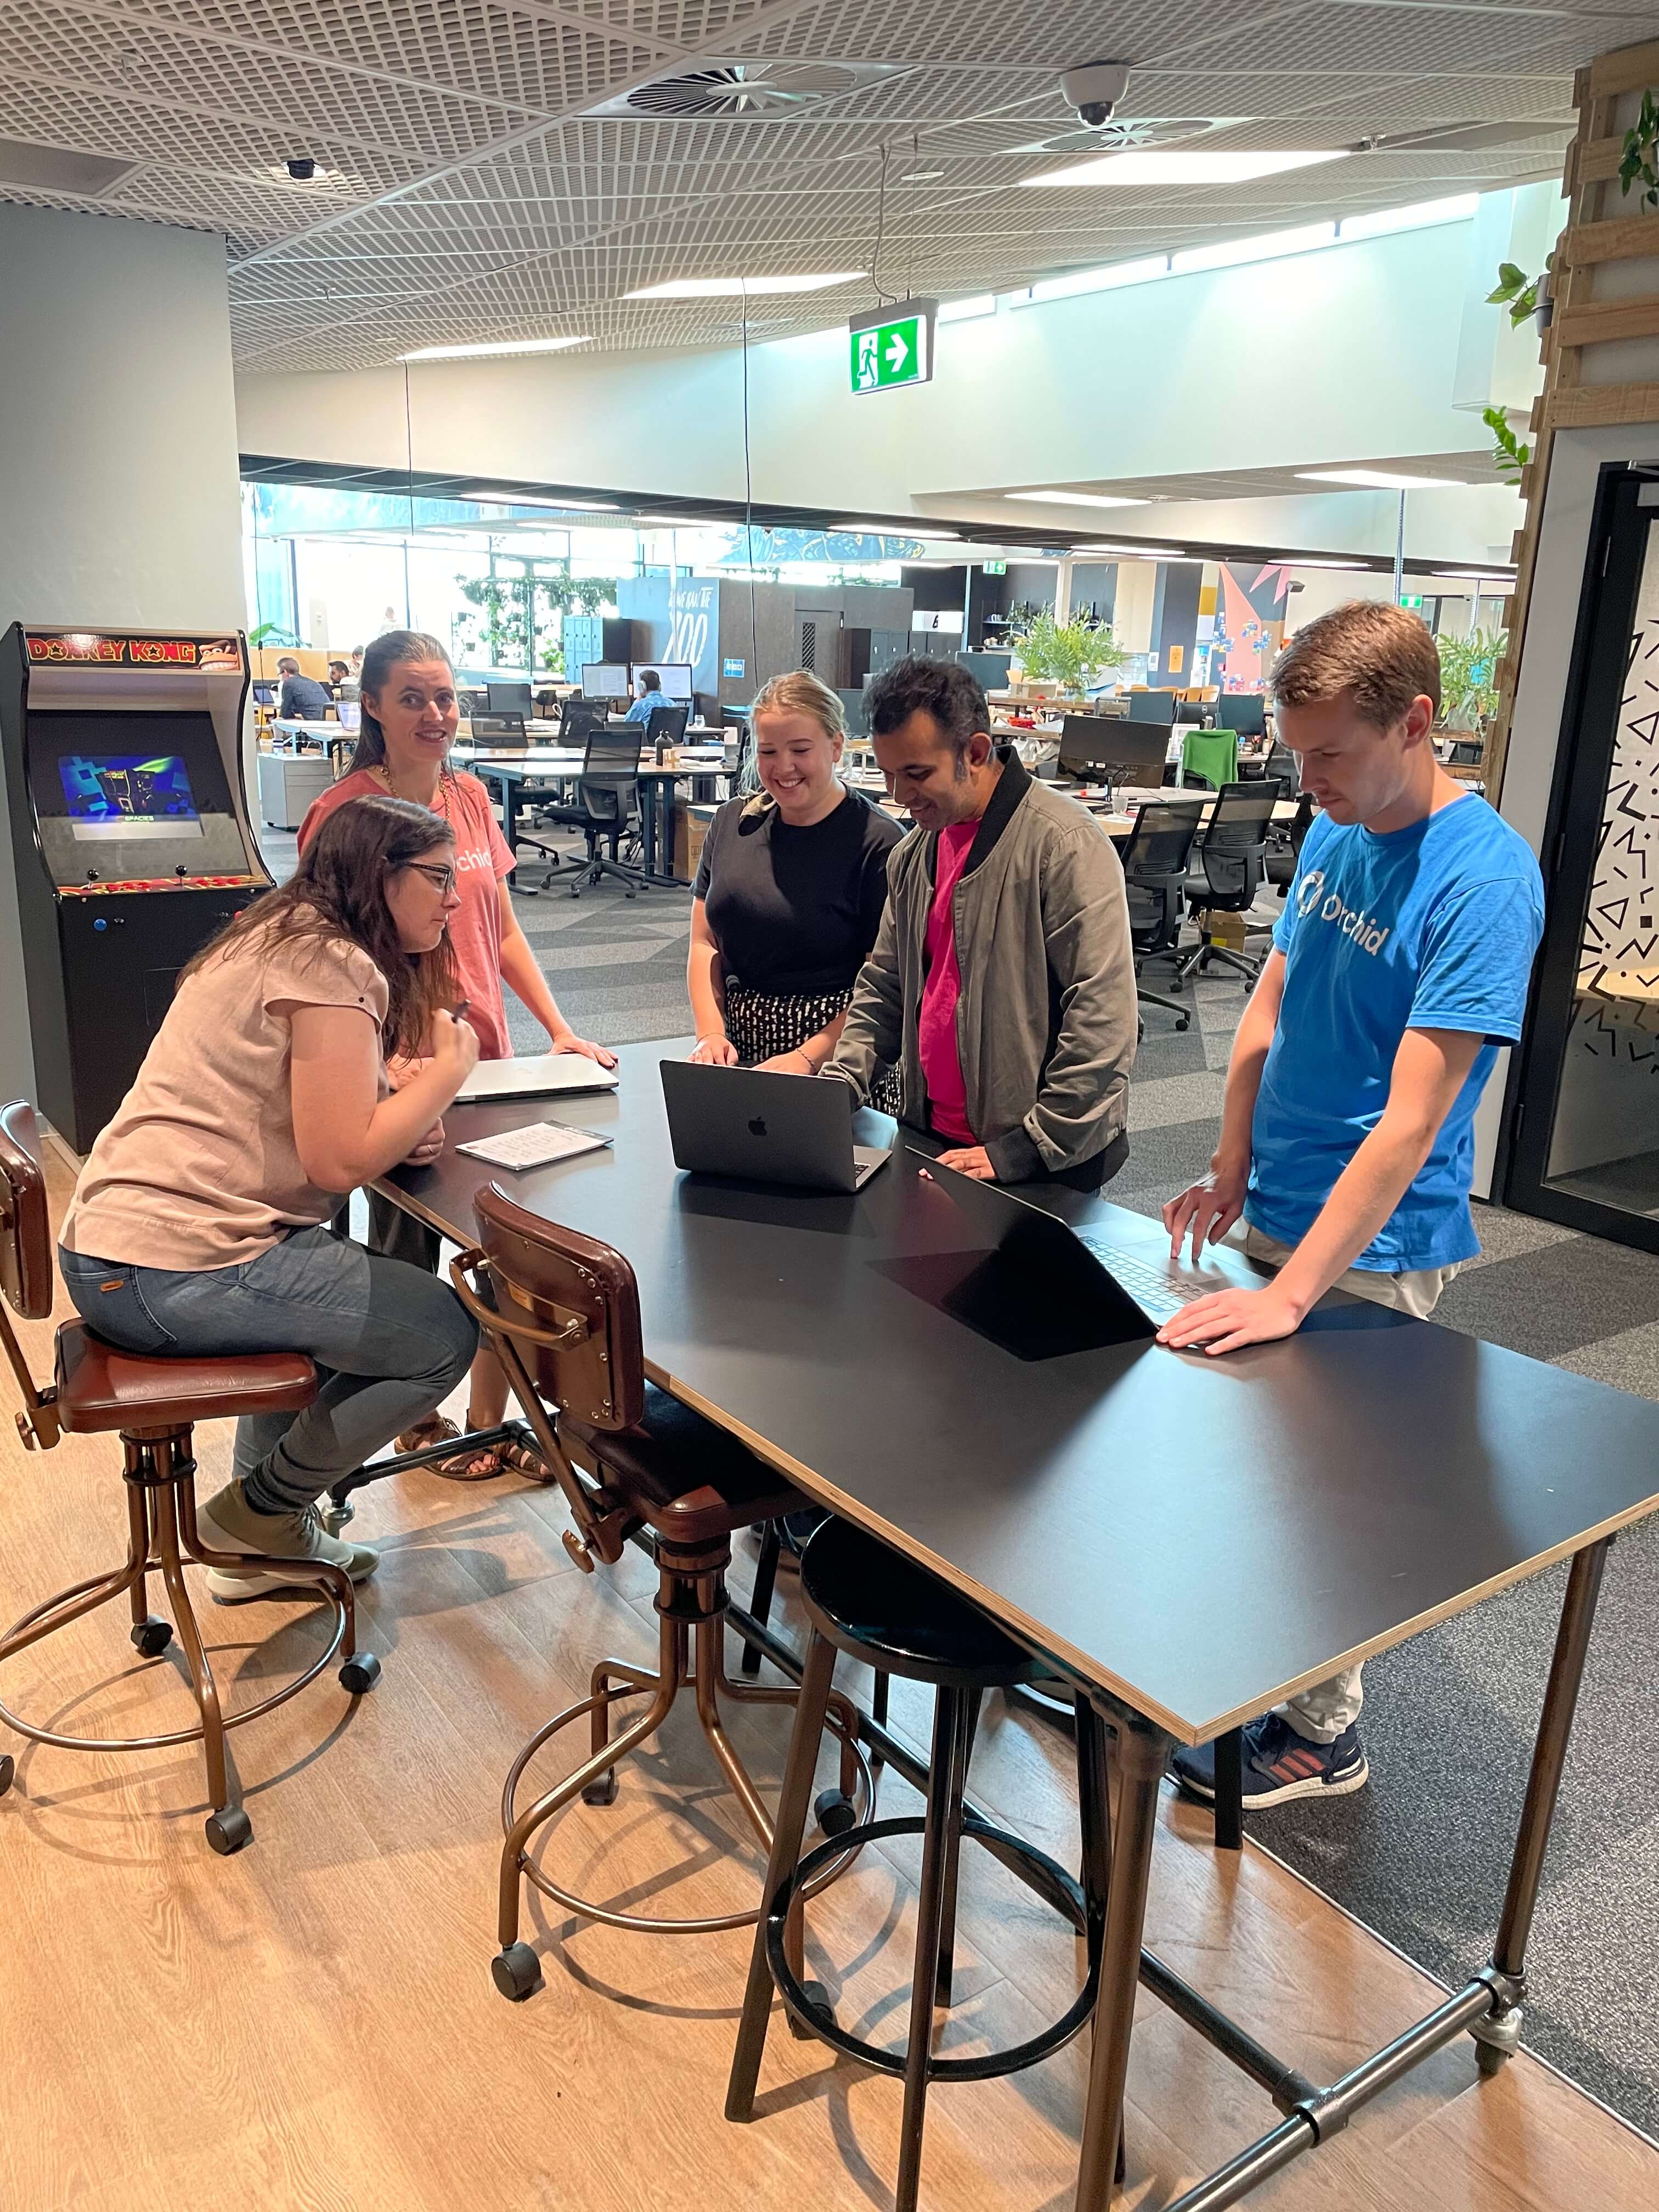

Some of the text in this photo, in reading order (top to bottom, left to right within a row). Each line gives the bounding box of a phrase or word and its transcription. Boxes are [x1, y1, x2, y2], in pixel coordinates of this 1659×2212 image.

[701, 586, 713, 608] THE
[26, 638, 196, 663] DONKEY KONG
[661, 611, 708, 668] ZOO
[456, 848, 492, 872] chid
[1321, 894, 1390, 956] Orchid
